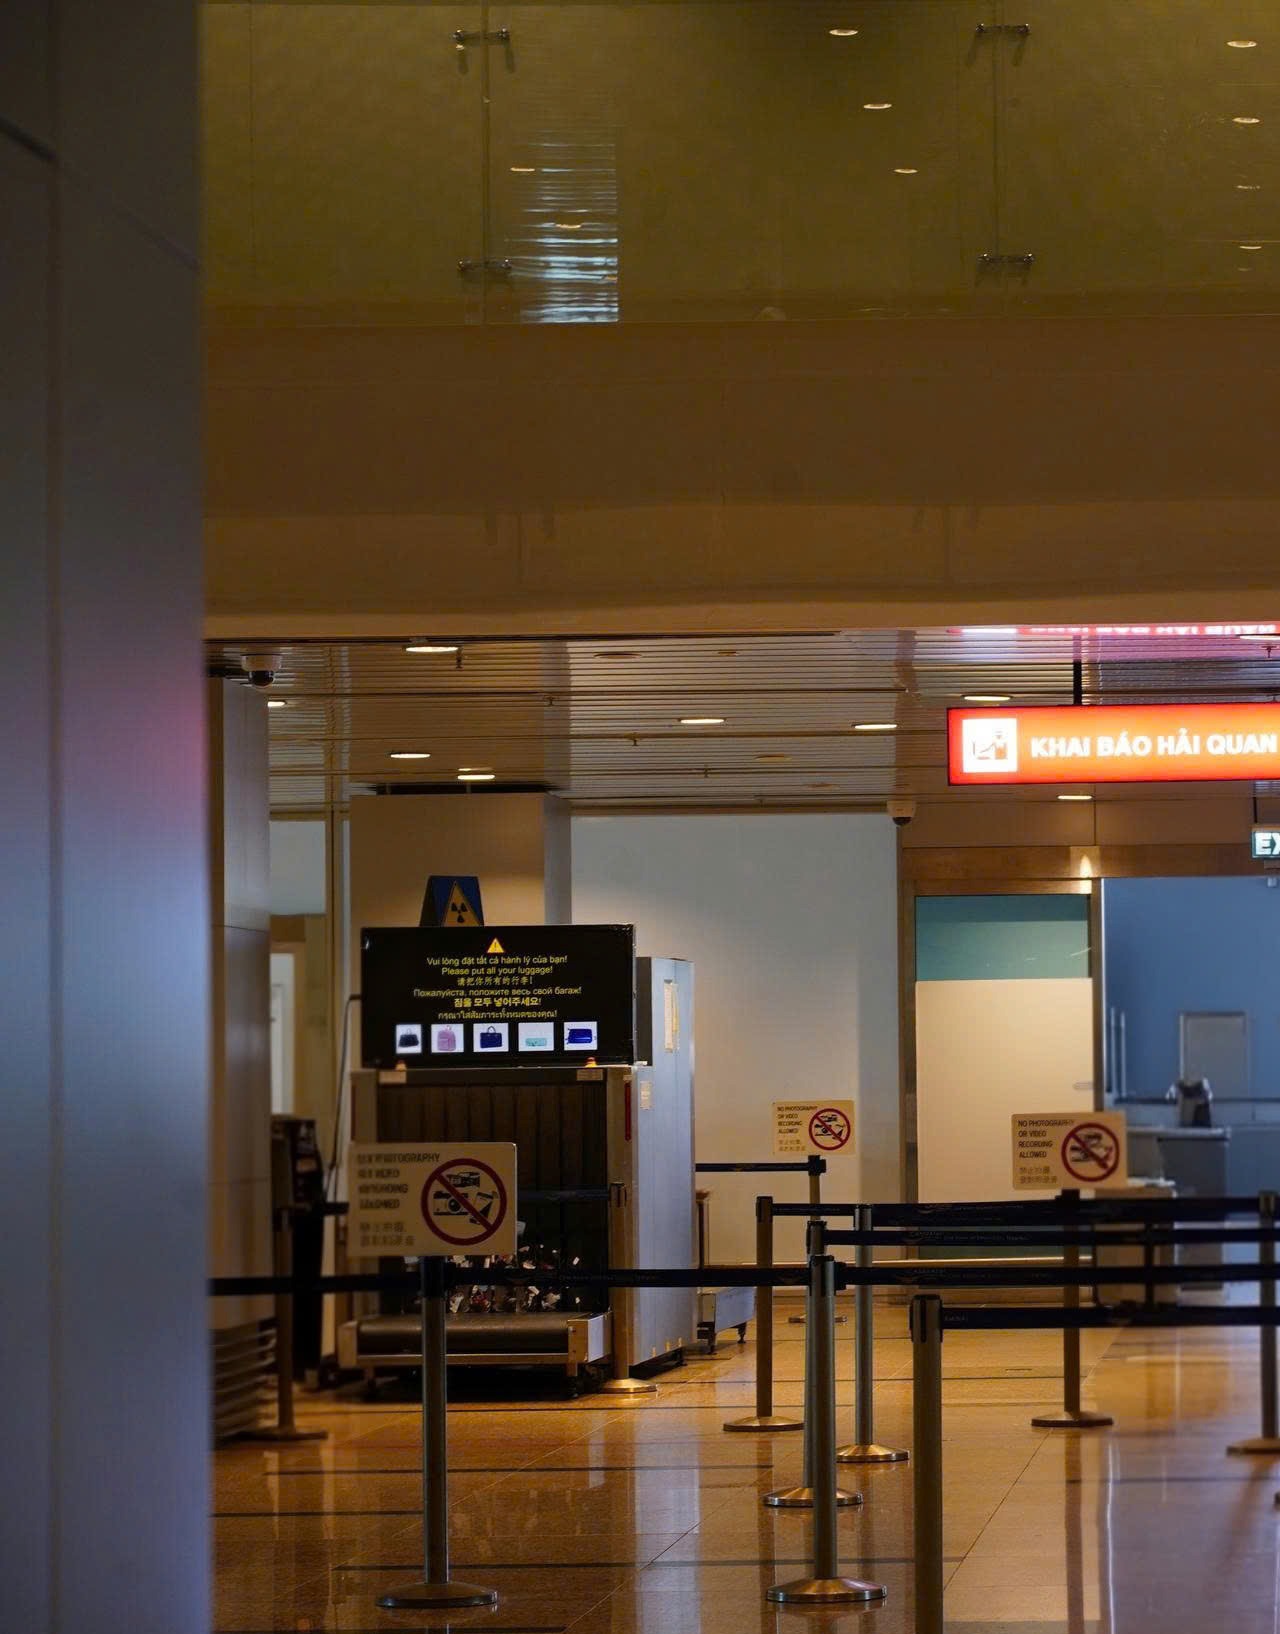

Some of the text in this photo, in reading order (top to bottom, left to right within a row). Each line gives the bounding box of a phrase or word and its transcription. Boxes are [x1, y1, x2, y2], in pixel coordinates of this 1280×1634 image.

[1030, 728, 1278, 758] KHAI BÁO HẢI QUAN
[427, 957, 440, 965] Vui
[442, 956, 460, 966] lòng
[523, 955, 531, 965] lý
[442, 966, 553, 977] Please put all your luggage!
[532, 987, 553, 995] свой
[554, 986, 582, 995] багаж!
[473, 997, 493, 1006] 모두
[1029, 1119, 1074, 1127] PHOTOGRAPHY
[1018, 1130, 1028, 1138] OR
[1018, 1140, 1053, 1148] RECORDING
